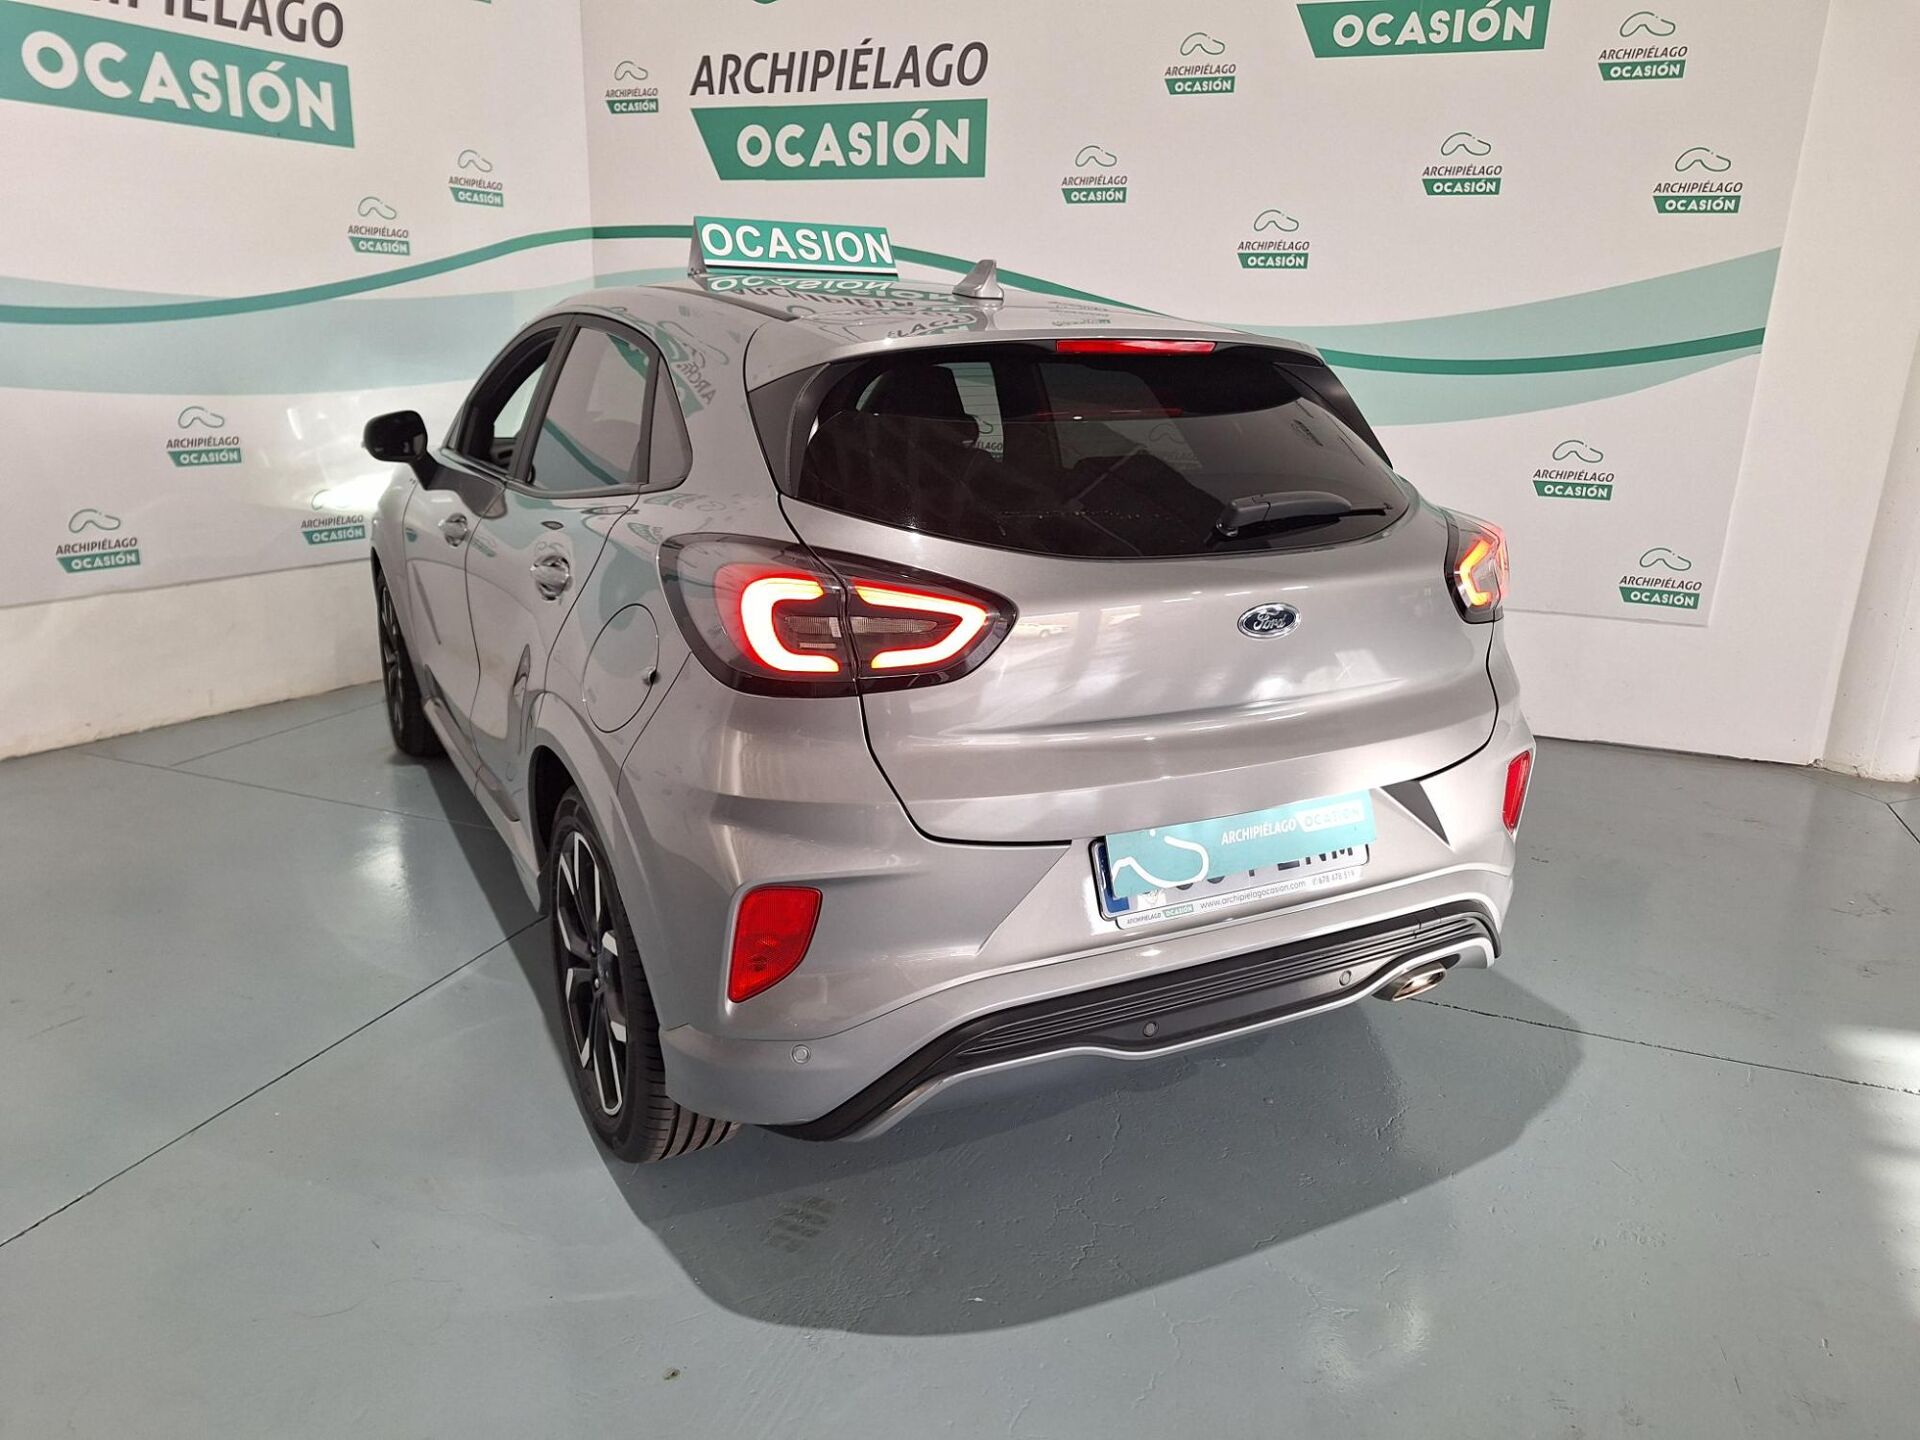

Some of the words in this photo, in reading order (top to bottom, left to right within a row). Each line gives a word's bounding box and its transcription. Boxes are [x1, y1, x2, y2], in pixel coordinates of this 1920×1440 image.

[1333, 0, 1535, 47] OCASIÓN
[1598, 45, 1688, 60] ARCHIPIÉLAGO
[690, 38, 989, 96] ARCHIPIÉLAGO
[1165, 62, 1235, 76] ARCHIPIÉLAGO
[1609, 61, 1681, 78] OCASIÓN
[21, 31, 336, 131] OCASIÓN
[1174, 78, 1232, 93] OCASIÓN
[605, 87, 657, 98] ARCHIPIÉLAGO
[613, 100, 656, 111] OCASIÓN
[736, 109, 970, 168] OCASIÓN
[1422, 163, 1502, 177] ARCHIPIÉLAGO
[449, 176, 503, 190] ARCHIPIÉLAGO
[1061, 174, 1128, 186] ARCHIPIÉLAGO
[1432, 179, 1497, 194] OCASIÓN
[1653, 180, 1743, 194] ARCHIPIÉLAGO
[457, 190, 501, 205] OCASIÓN
[1070, 188, 1124, 202] OCASIÓN
[1665, 196, 1736, 212] OCASIÓN
[348, 225, 409, 239] ARCHIPIÉLAGO
[358, 239, 408, 254] OCASIÓN
[701, 223, 893, 264] OCASION
[1238, 239, 1310, 251] ARCHIPIÉLAGO
[1247, 254, 1305, 267] OCASIÓN
[166, 435, 239, 448] ARCHIPIÉLAGO
[180, 450, 238, 464] OCASIÓN
[1533, 468, 1615, 483] ARCHIPIÉLAGO
[1544, 483, 1609, 499] OCASIÓN
[301, 514, 364, 528] ARCHIPIÉLAGO
[311, 527, 363, 542] OCASIÓN
[56, 536, 138, 554] ARCHIPIÉLAGO
[71, 551, 137, 568] OCASIÓN
[1619, 575, 1702, 591] ARCHIPIÉLAGO
[1630, 590, 1695, 607] OCASIÓN
[1253, 608, 1287, 631] Ford
[1221, 818, 1297, 846] ARCHIPIÉLAGO
